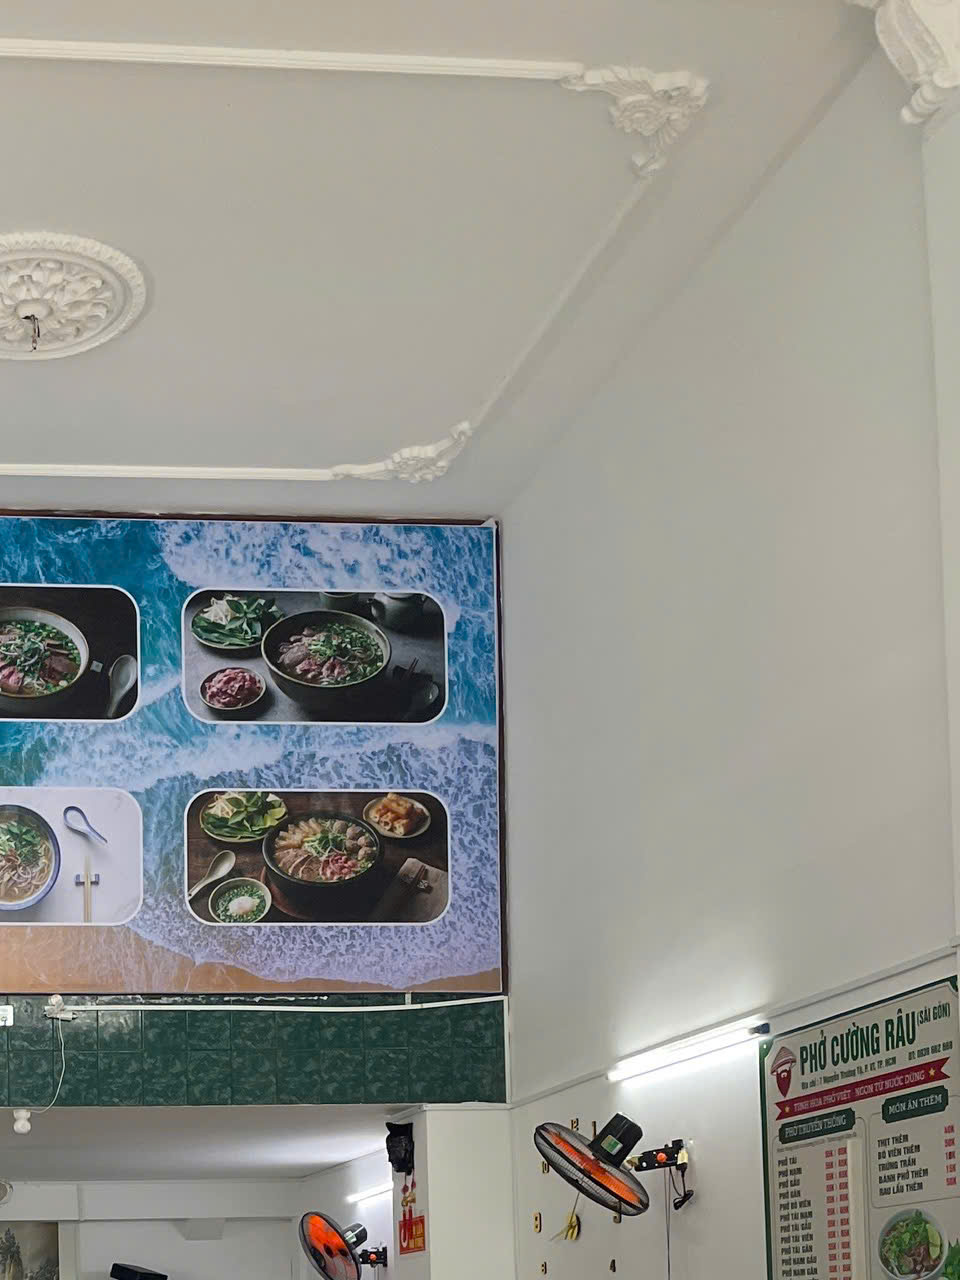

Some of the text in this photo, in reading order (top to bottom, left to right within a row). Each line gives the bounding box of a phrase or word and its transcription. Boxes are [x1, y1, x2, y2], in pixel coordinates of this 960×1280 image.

[800, 1030, 826, 1076] PHỞ
[831, 1022, 880, 1067] CƯỜNG
[885, 1008, 916, 1052] RÂU
[919, 1093, 942, 1108] THÊM
